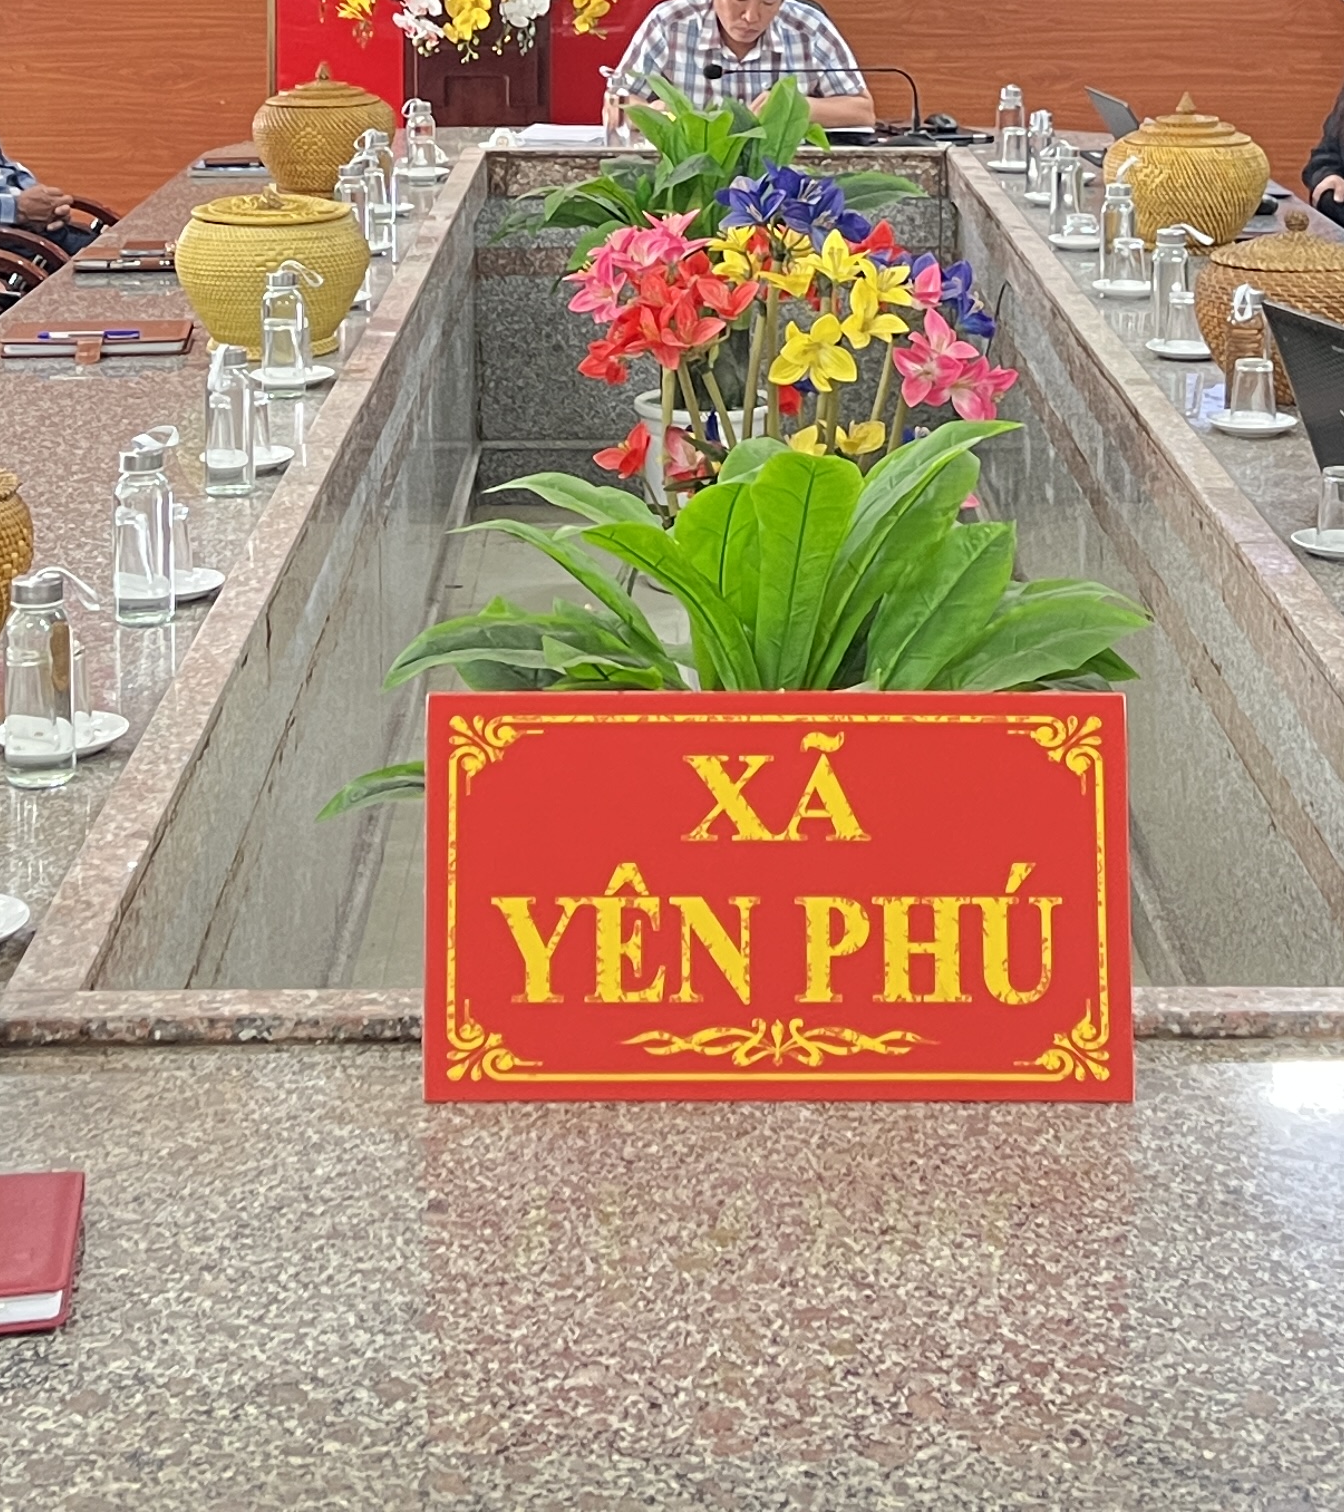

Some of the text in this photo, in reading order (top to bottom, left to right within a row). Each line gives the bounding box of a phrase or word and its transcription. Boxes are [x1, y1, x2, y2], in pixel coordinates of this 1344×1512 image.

[680, 731, 873, 842] XÃ
[490, 862, 1064, 1005] YÊN PHÚ
